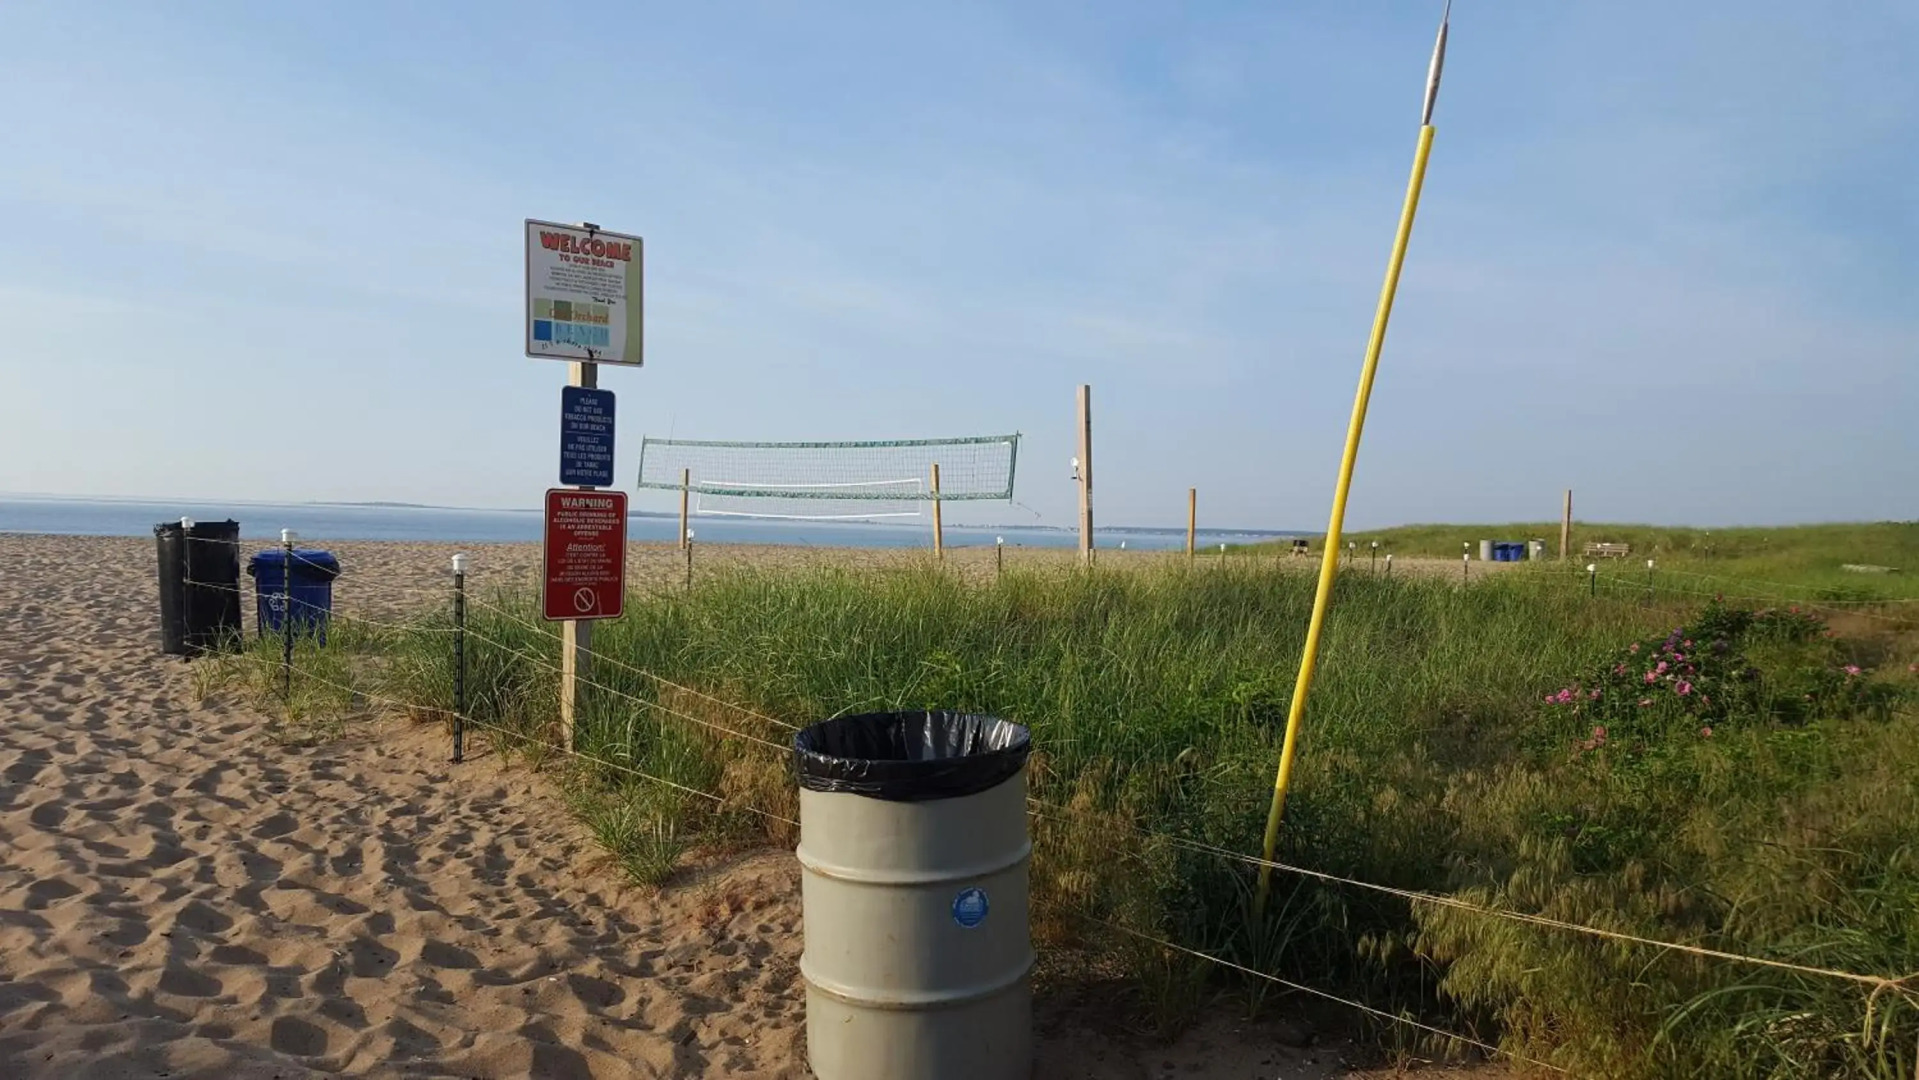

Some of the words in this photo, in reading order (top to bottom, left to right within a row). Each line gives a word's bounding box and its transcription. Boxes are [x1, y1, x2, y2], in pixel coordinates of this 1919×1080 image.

[540, 231, 632, 261] WELCOME
[559, 254, 570, 262] TO
[573, 256, 590, 265] OUR
[592, 258, 615, 268] BEACH
[580, 398, 598, 406] PLEASE
[561, 497, 613, 508] WARNING
